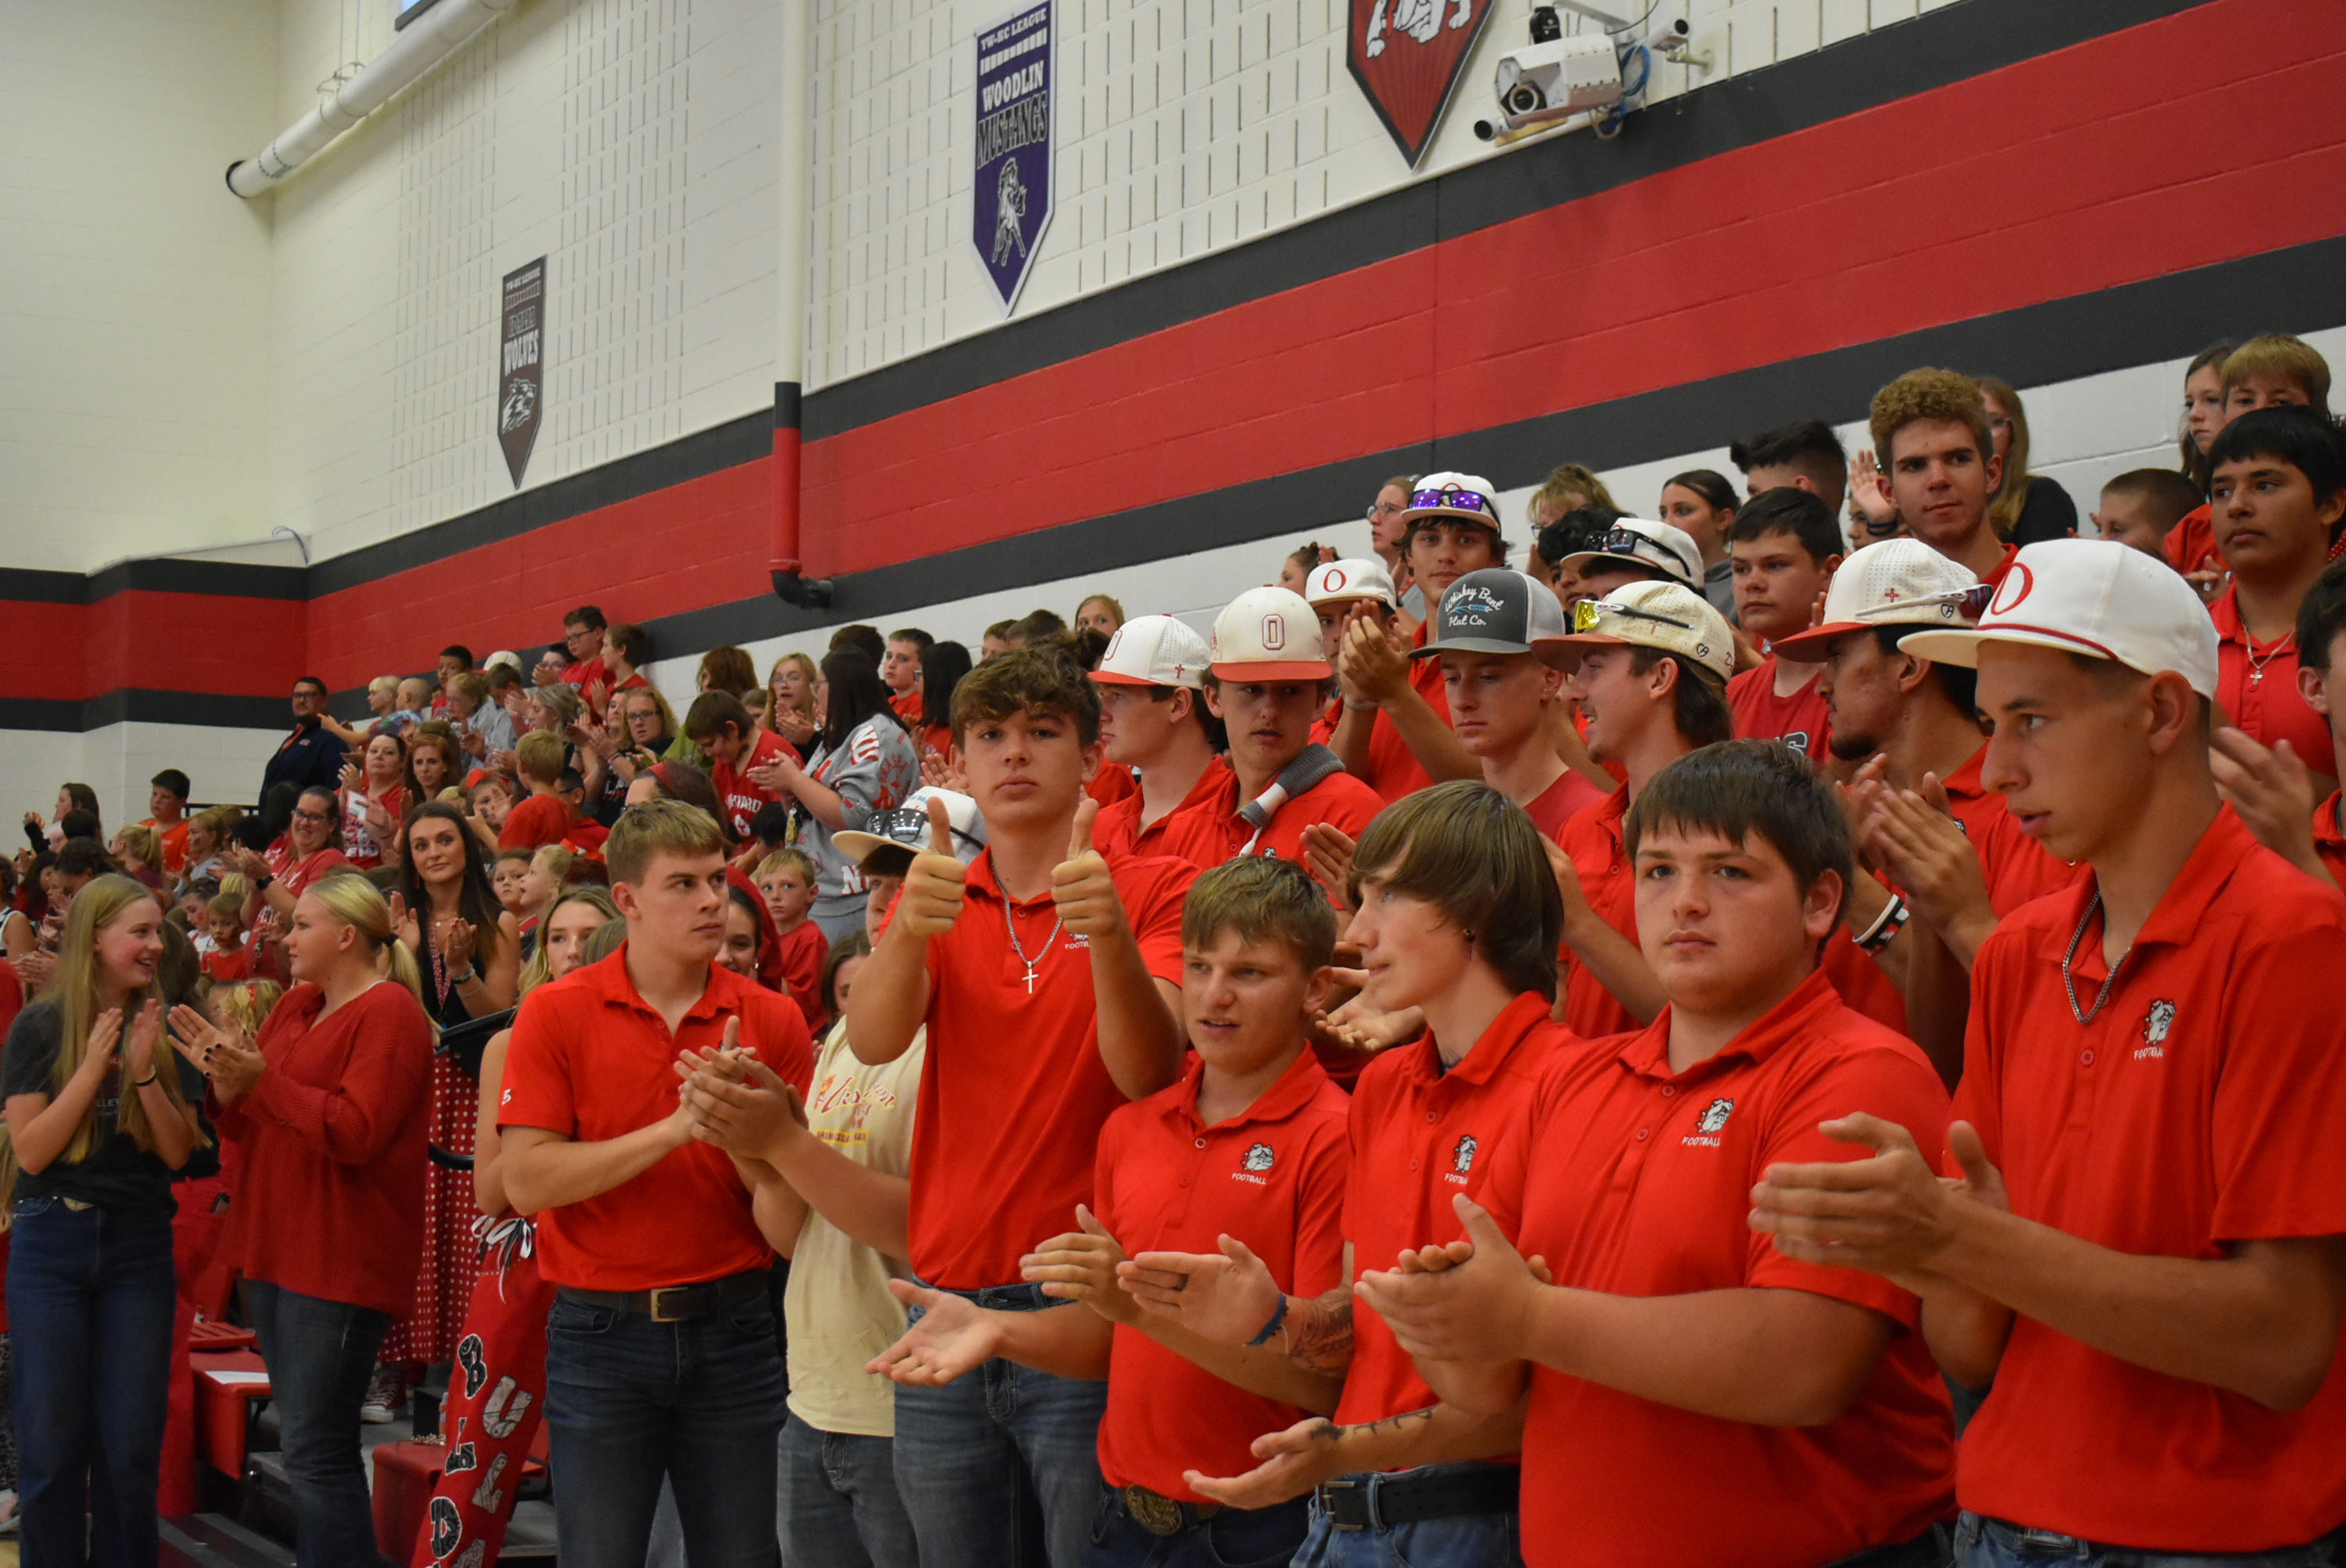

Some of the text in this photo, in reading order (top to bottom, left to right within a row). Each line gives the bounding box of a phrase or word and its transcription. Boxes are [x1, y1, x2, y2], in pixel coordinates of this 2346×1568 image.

[1011, 7, 1048, 36] LEAGUE
[982, 60, 1044, 113] WOODLIN
[977, 90, 1048, 170] MUSTANGS
[504, 329, 539, 377] WOLVES
[1324, 569, 1347, 593] O
[1445, 583, 1505, 612] Whiskey Bent
[1448, 615, 1487, 627] Hat Co.
[1065, 941, 1090, 949] FOOTB
[2134, 1047, 2164, 1060] FOOTBA
[1682, 1136, 1721, 1147] FOOTBALL
[1231, 1173, 1266, 1185] FOOTBALL
